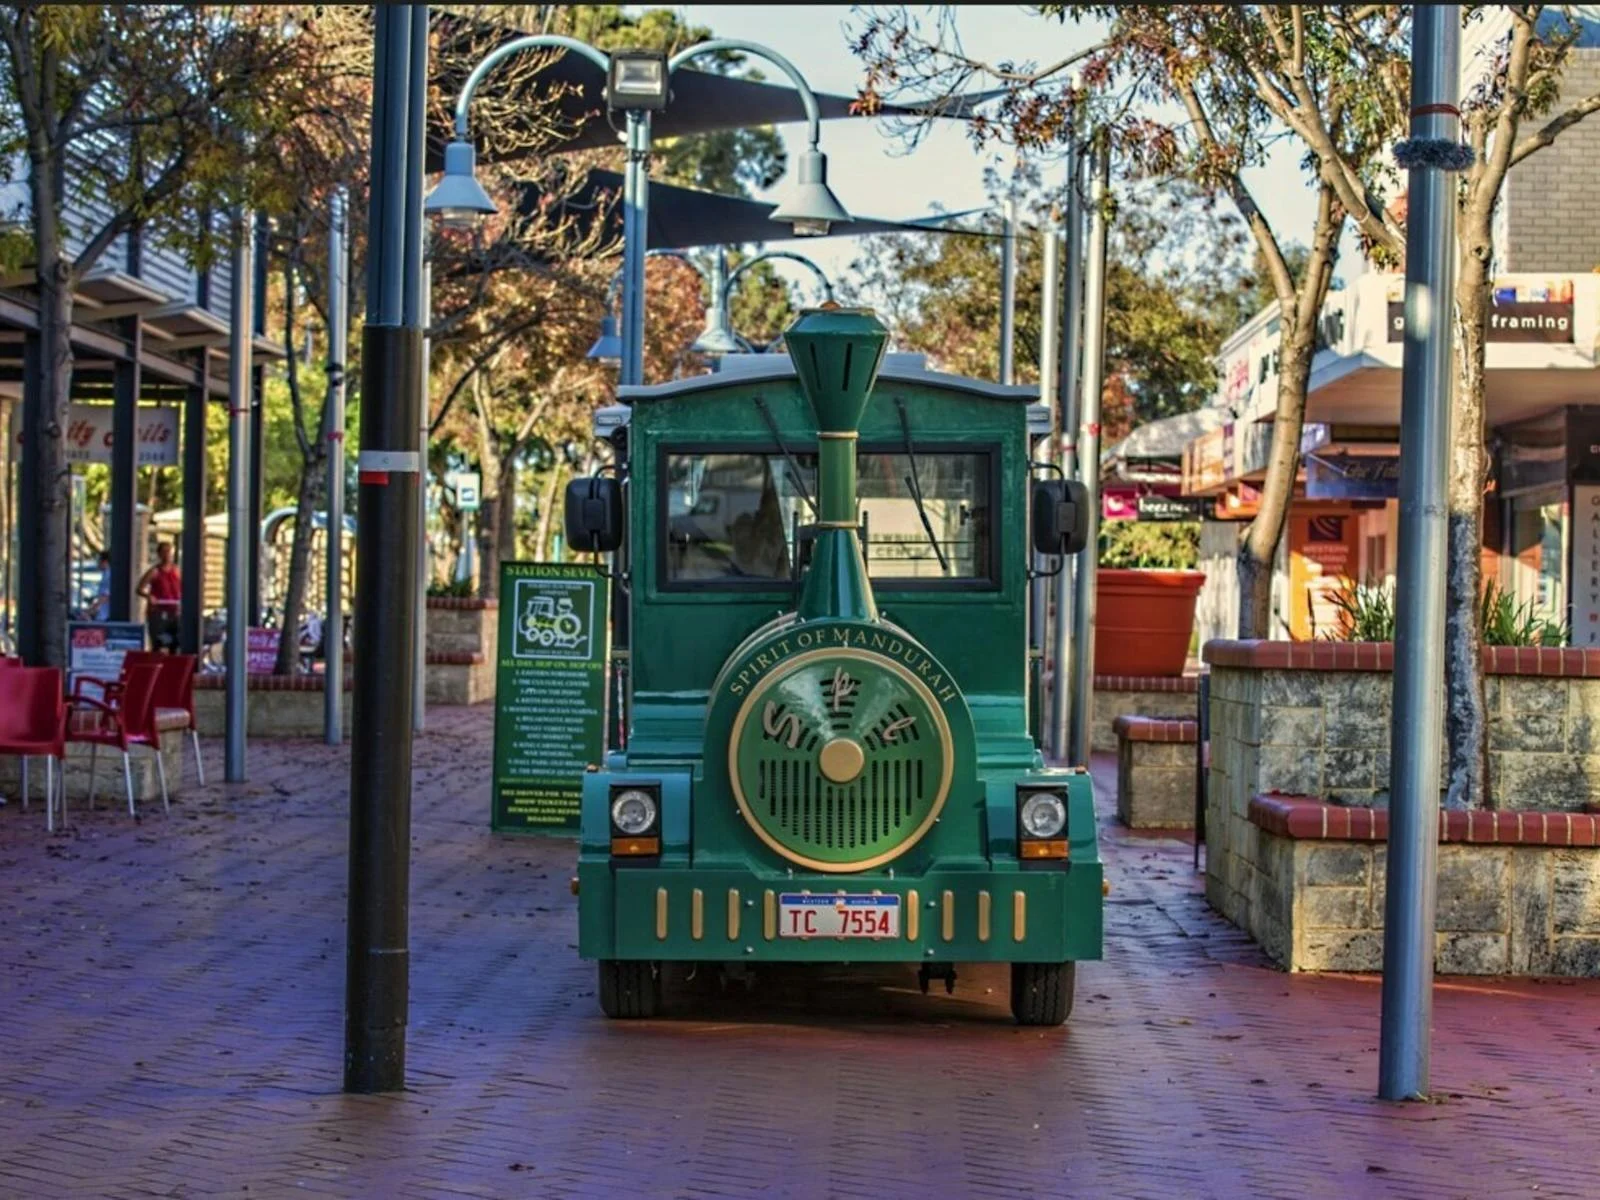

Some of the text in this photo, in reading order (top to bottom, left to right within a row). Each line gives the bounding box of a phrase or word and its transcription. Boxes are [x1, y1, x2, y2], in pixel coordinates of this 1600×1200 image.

[1492, 314, 1568, 331] framing
[505, 565, 560, 577] STATION
[730, 638, 791, 697] SPIRIT
[797, 627, 827, 647] OF
[832, 627, 957, 702] MANDURAH
[788, 909, 890, 935] TC 7554
